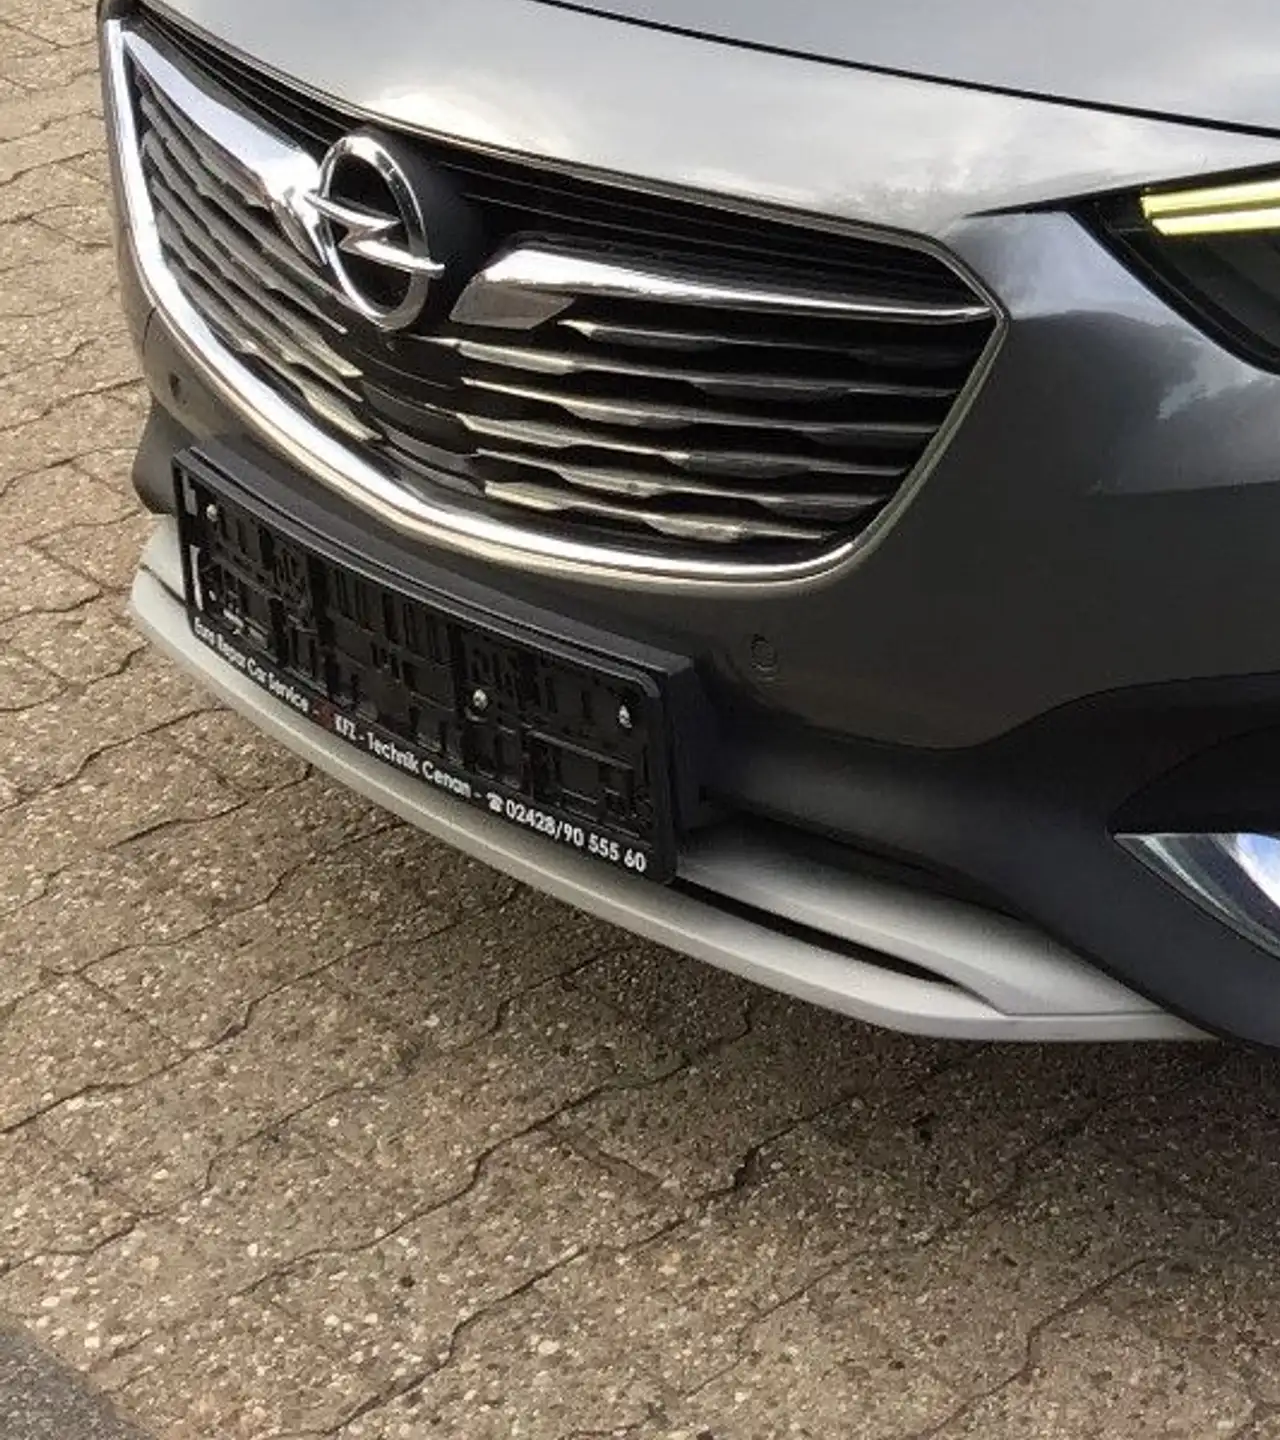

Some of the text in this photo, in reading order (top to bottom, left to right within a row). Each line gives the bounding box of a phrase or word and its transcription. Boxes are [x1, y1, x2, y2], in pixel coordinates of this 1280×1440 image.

[367, 731, 420, 775] Technik
[505, 799, 585, 847] 02428/90
[587, 833, 620, 861] 555
[623, 848, 647, 873] 60
